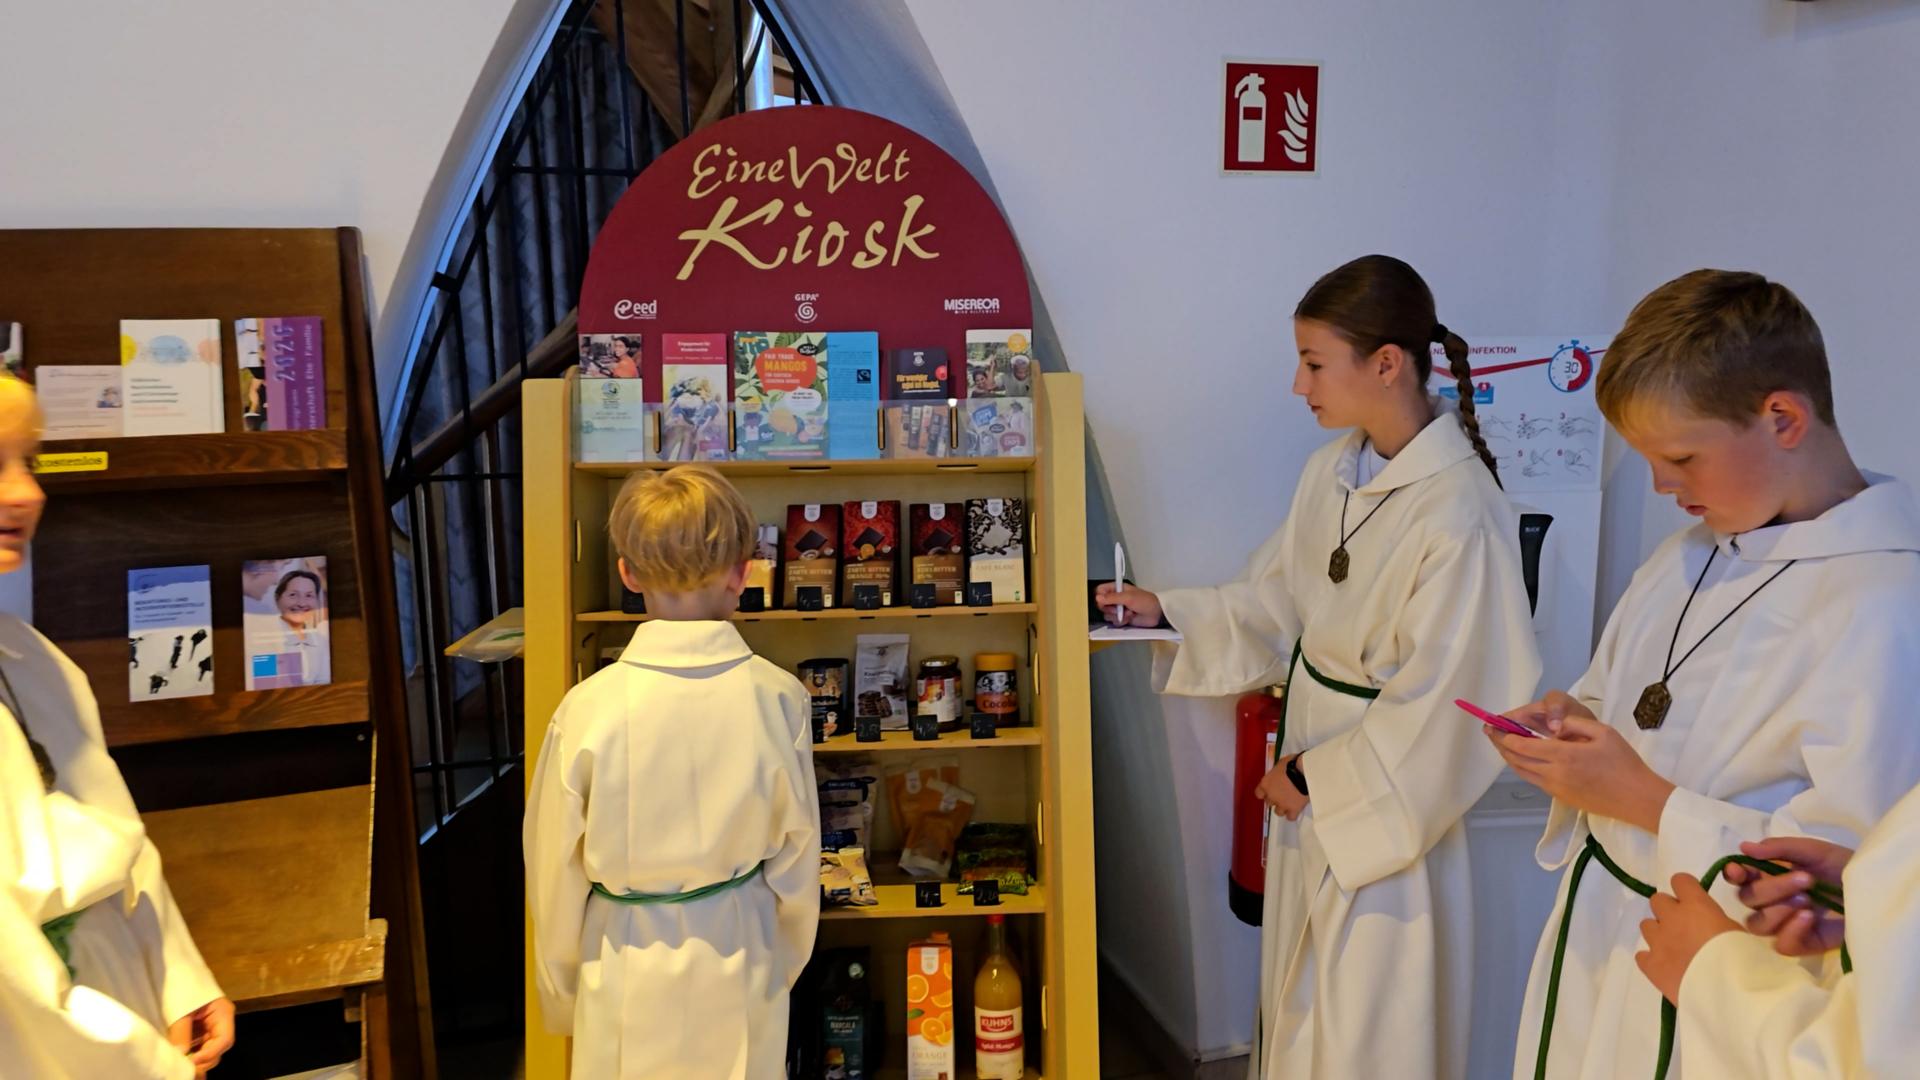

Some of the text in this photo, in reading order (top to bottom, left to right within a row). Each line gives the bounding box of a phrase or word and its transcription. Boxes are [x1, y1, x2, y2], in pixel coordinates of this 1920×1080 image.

[676, 194, 940, 280] Kiosk
[944, 298, 1000, 310] MISEREOR
[304, 324, 313, 356] Familie
[764, 360, 807, 371] MANGOS
[1564, 361, 1578, 373] 30
[1520, 413, 1526, 421] 2
[1560, 412, 1565, 420] 3
